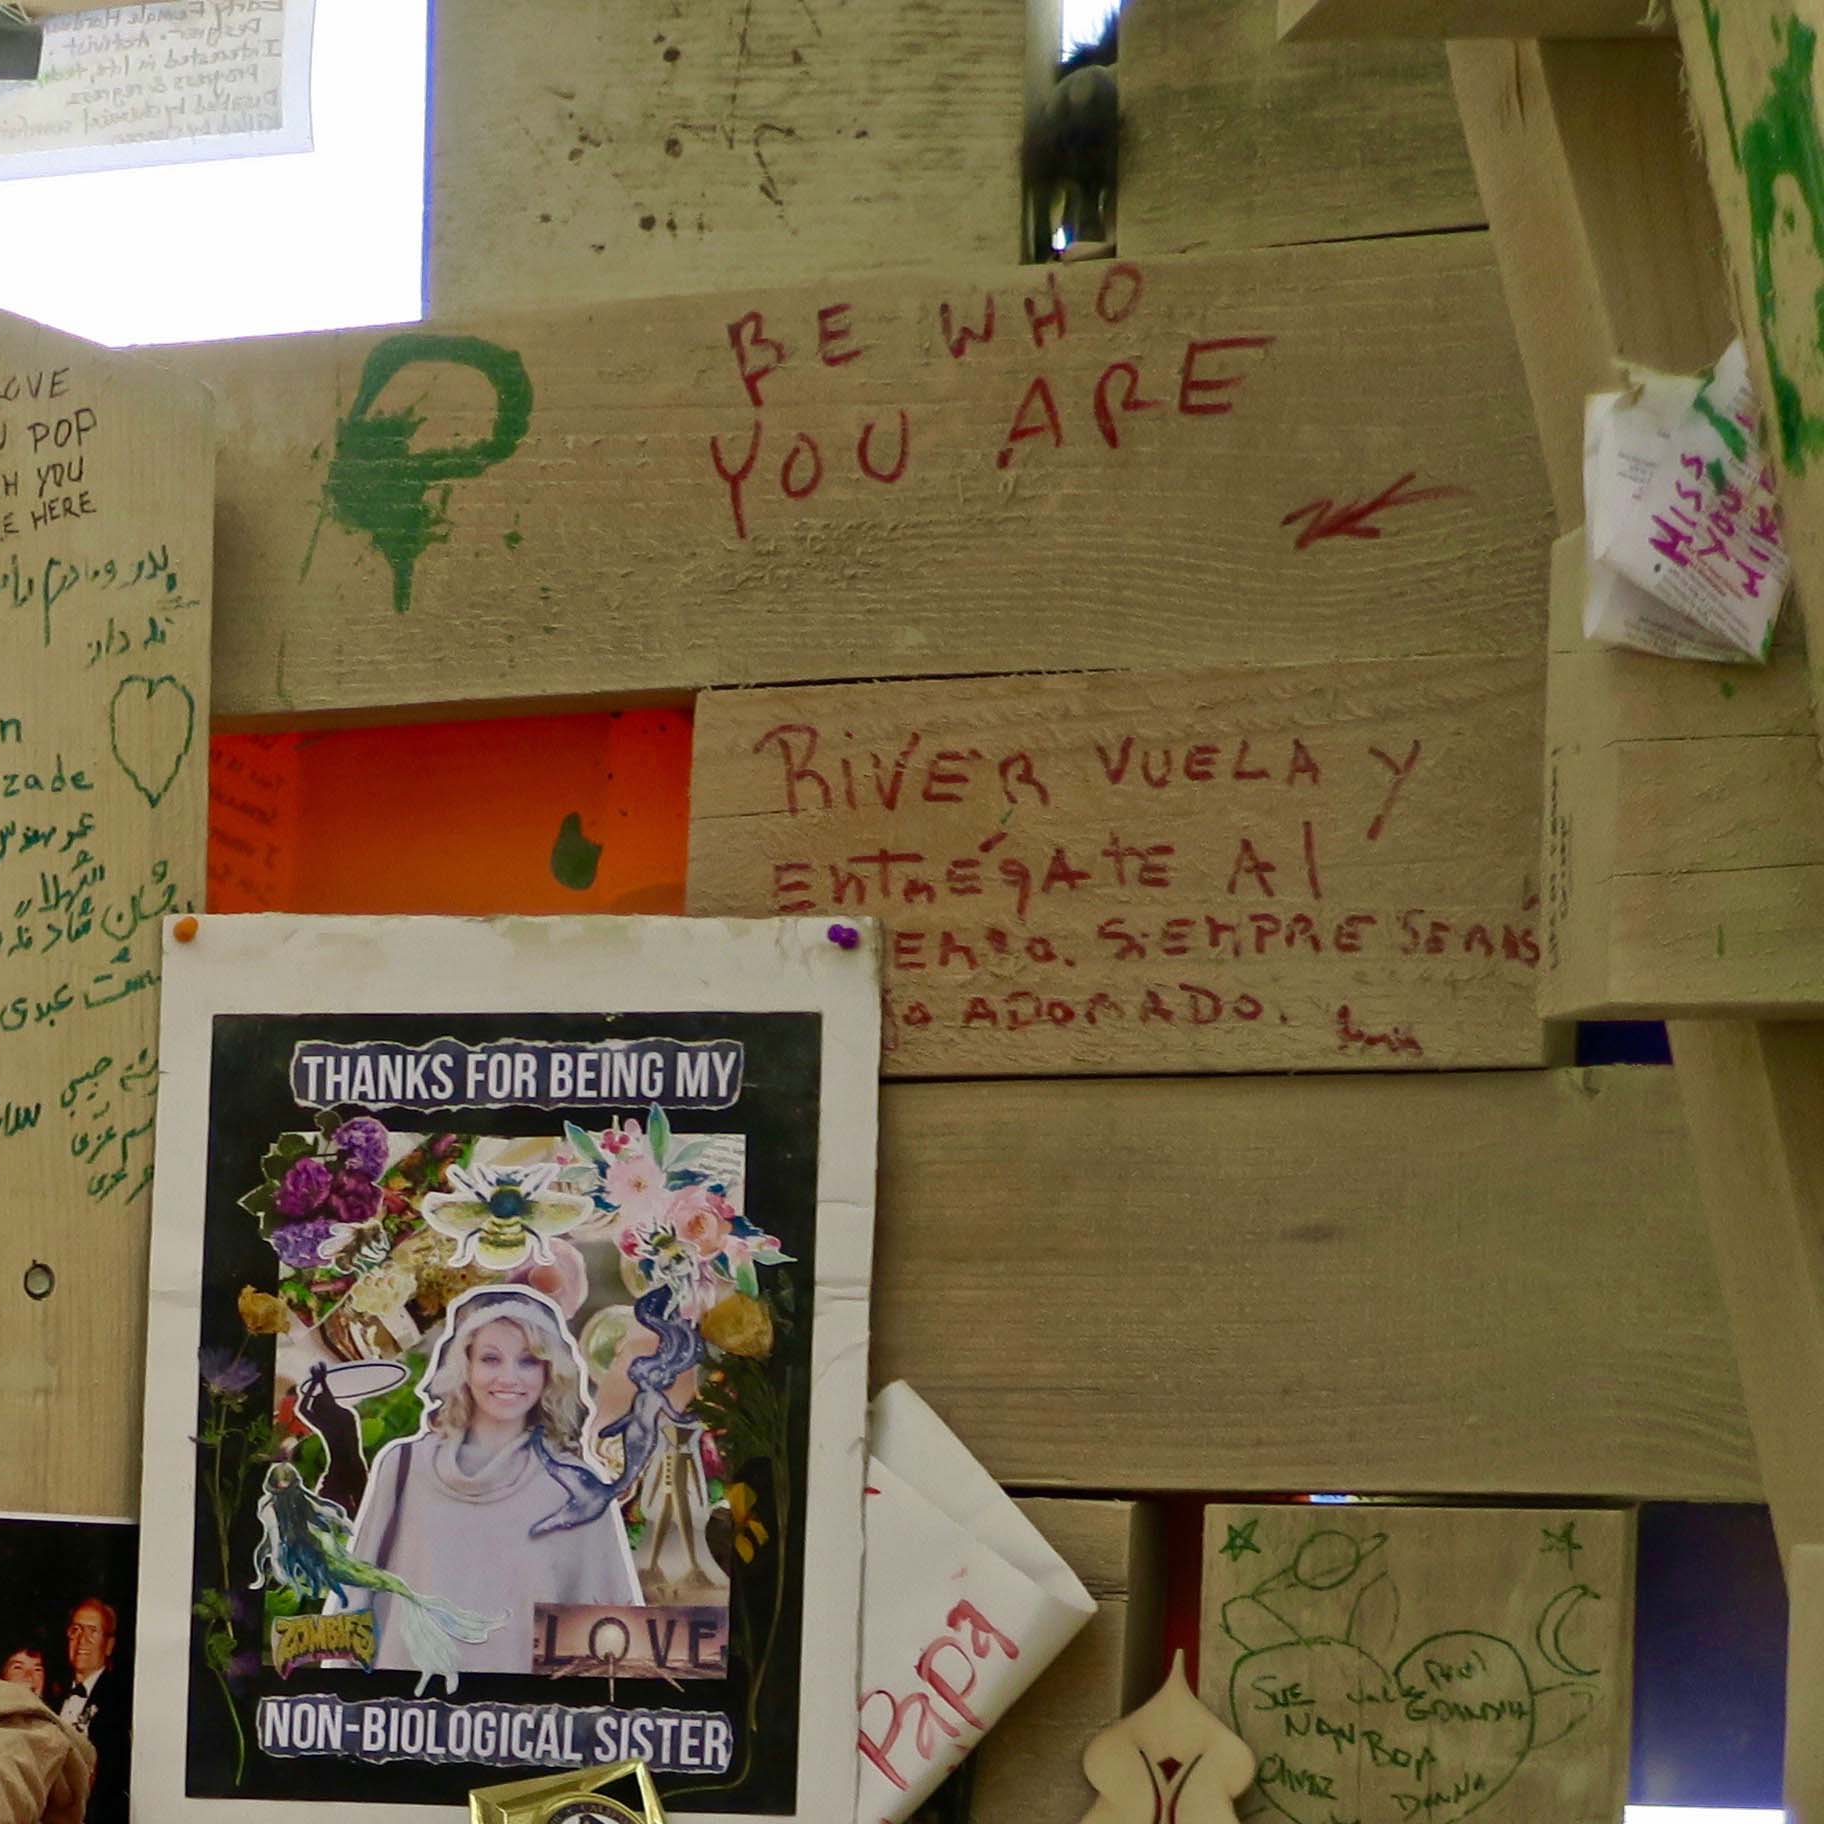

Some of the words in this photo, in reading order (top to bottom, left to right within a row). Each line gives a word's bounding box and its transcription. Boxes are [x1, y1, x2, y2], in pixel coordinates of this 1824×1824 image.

[727, 303, 864, 407] BE
[939, 262, 1144, 360] WHO
[27, 406, 98, 454] POP
[36, 456, 85, 498] YOU
[709, 408, 911, 540] YOU
[31, 490, 98, 530] HERE
[303, 1051, 455, 1102] THANKS
[465, 1051, 539, 1100] FOR
[547, 1049, 666, 1099] BEING
[674, 1049, 739, 1099] MY
[261, 1697, 581, 1764] NON-BIOLOGICAL
[594, 1710, 732, 1770] SISTER
